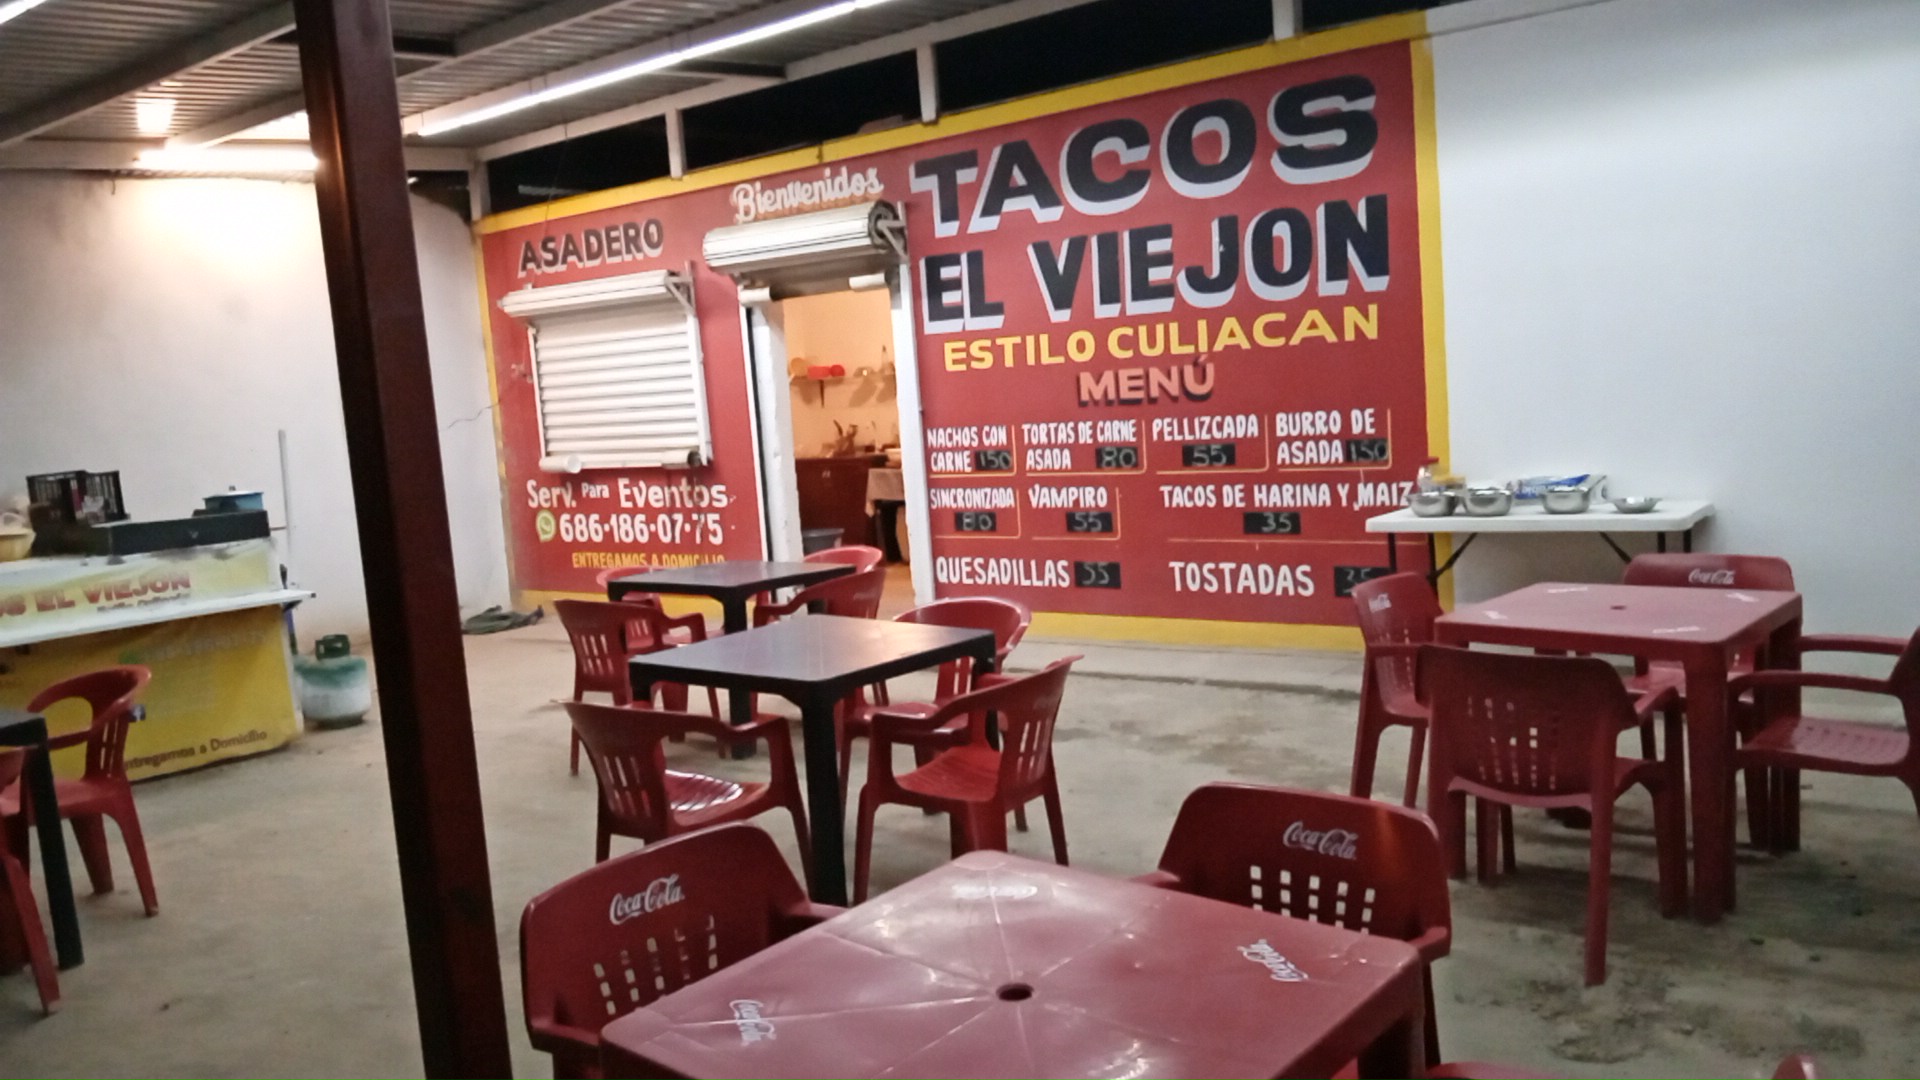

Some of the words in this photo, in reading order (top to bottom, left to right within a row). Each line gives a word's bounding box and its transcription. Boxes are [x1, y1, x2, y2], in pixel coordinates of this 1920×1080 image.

[909, 74, 1378, 238] TACOS
[731, 167, 884, 223] Bienvenidos
[517, 218, 664, 278] ASADERO
[919, 250, 1005, 335] EL
[1026, 194, 1390, 322] VIEJON
[943, 330, 1096, 372] ESTILO
[1107, 304, 1379, 359] CULIACAN
[1077, 355, 1215, 407] MENÚ
[926, 426, 979, 448] NACHOS
[982, 425, 1007, 446] CON
[1021, 422, 1075, 446] TORTAS
[1078, 421, 1093, 444] DE
[1097, 419, 1138, 443] CARNE
[1152, 413, 1259, 441] PELLIZCADA
[1275, 410, 1342, 437] BURRO
[1351, 408, 1375, 435] DE
[930, 451, 972, 473] CARNE
[980, 451, 1012, 470] 150
[1026, 448, 1071, 471] ASADA
[1102, 447, 1137, 468] 80
[1276, 439, 1344, 465] ASADA
[527, 479, 577, 509] Serv.
[581, 482, 610, 499] Para
[617, 477, 729, 508] Eventos
[930, 487, 1015, 510] SINCRONIZADA
[1028, 484, 1107, 509] VAMPIRO
[1159, 484, 1216, 508] TACOS
[1222, 484, 1245, 508] DE
[1254, 483, 1331, 508] HARINA
[1337, 483, 1349, 507] Y
[1356, 481, 1414, 508] MAIZ
[1261, 512, 1293, 533] 35
[571, 552, 647, 569] ENTREGAMOS
[935, 556, 1071, 588] QUESADILLAS
[1168, 561, 1315, 597] TOSTADAS
[1283, 820, 1358, 860] Coca-Cola
[610, 874, 685, 925] Coca-Cola
